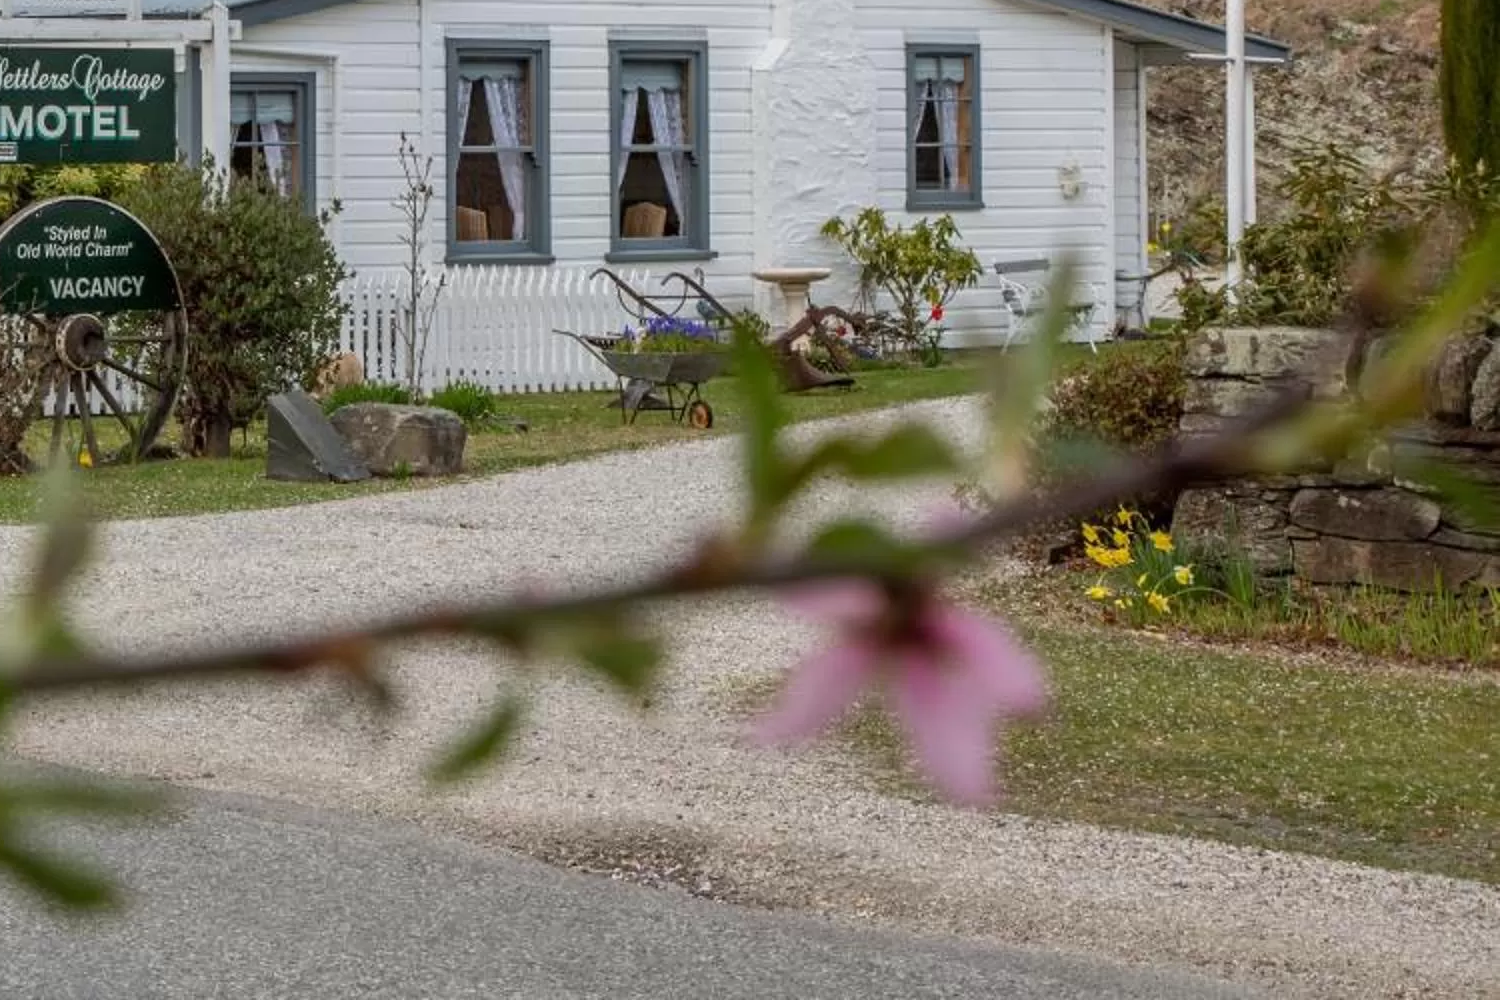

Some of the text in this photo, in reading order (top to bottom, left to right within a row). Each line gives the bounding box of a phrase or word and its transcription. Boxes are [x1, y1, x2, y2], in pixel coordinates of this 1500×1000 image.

[71, 54, 165, 103] Cottage
[0, 104, 141, 141] MOTEL
[16, 243, 41, 259] Old
[43, 242, 81, 258] World
[49, 275, 145, 300] VACANCY
